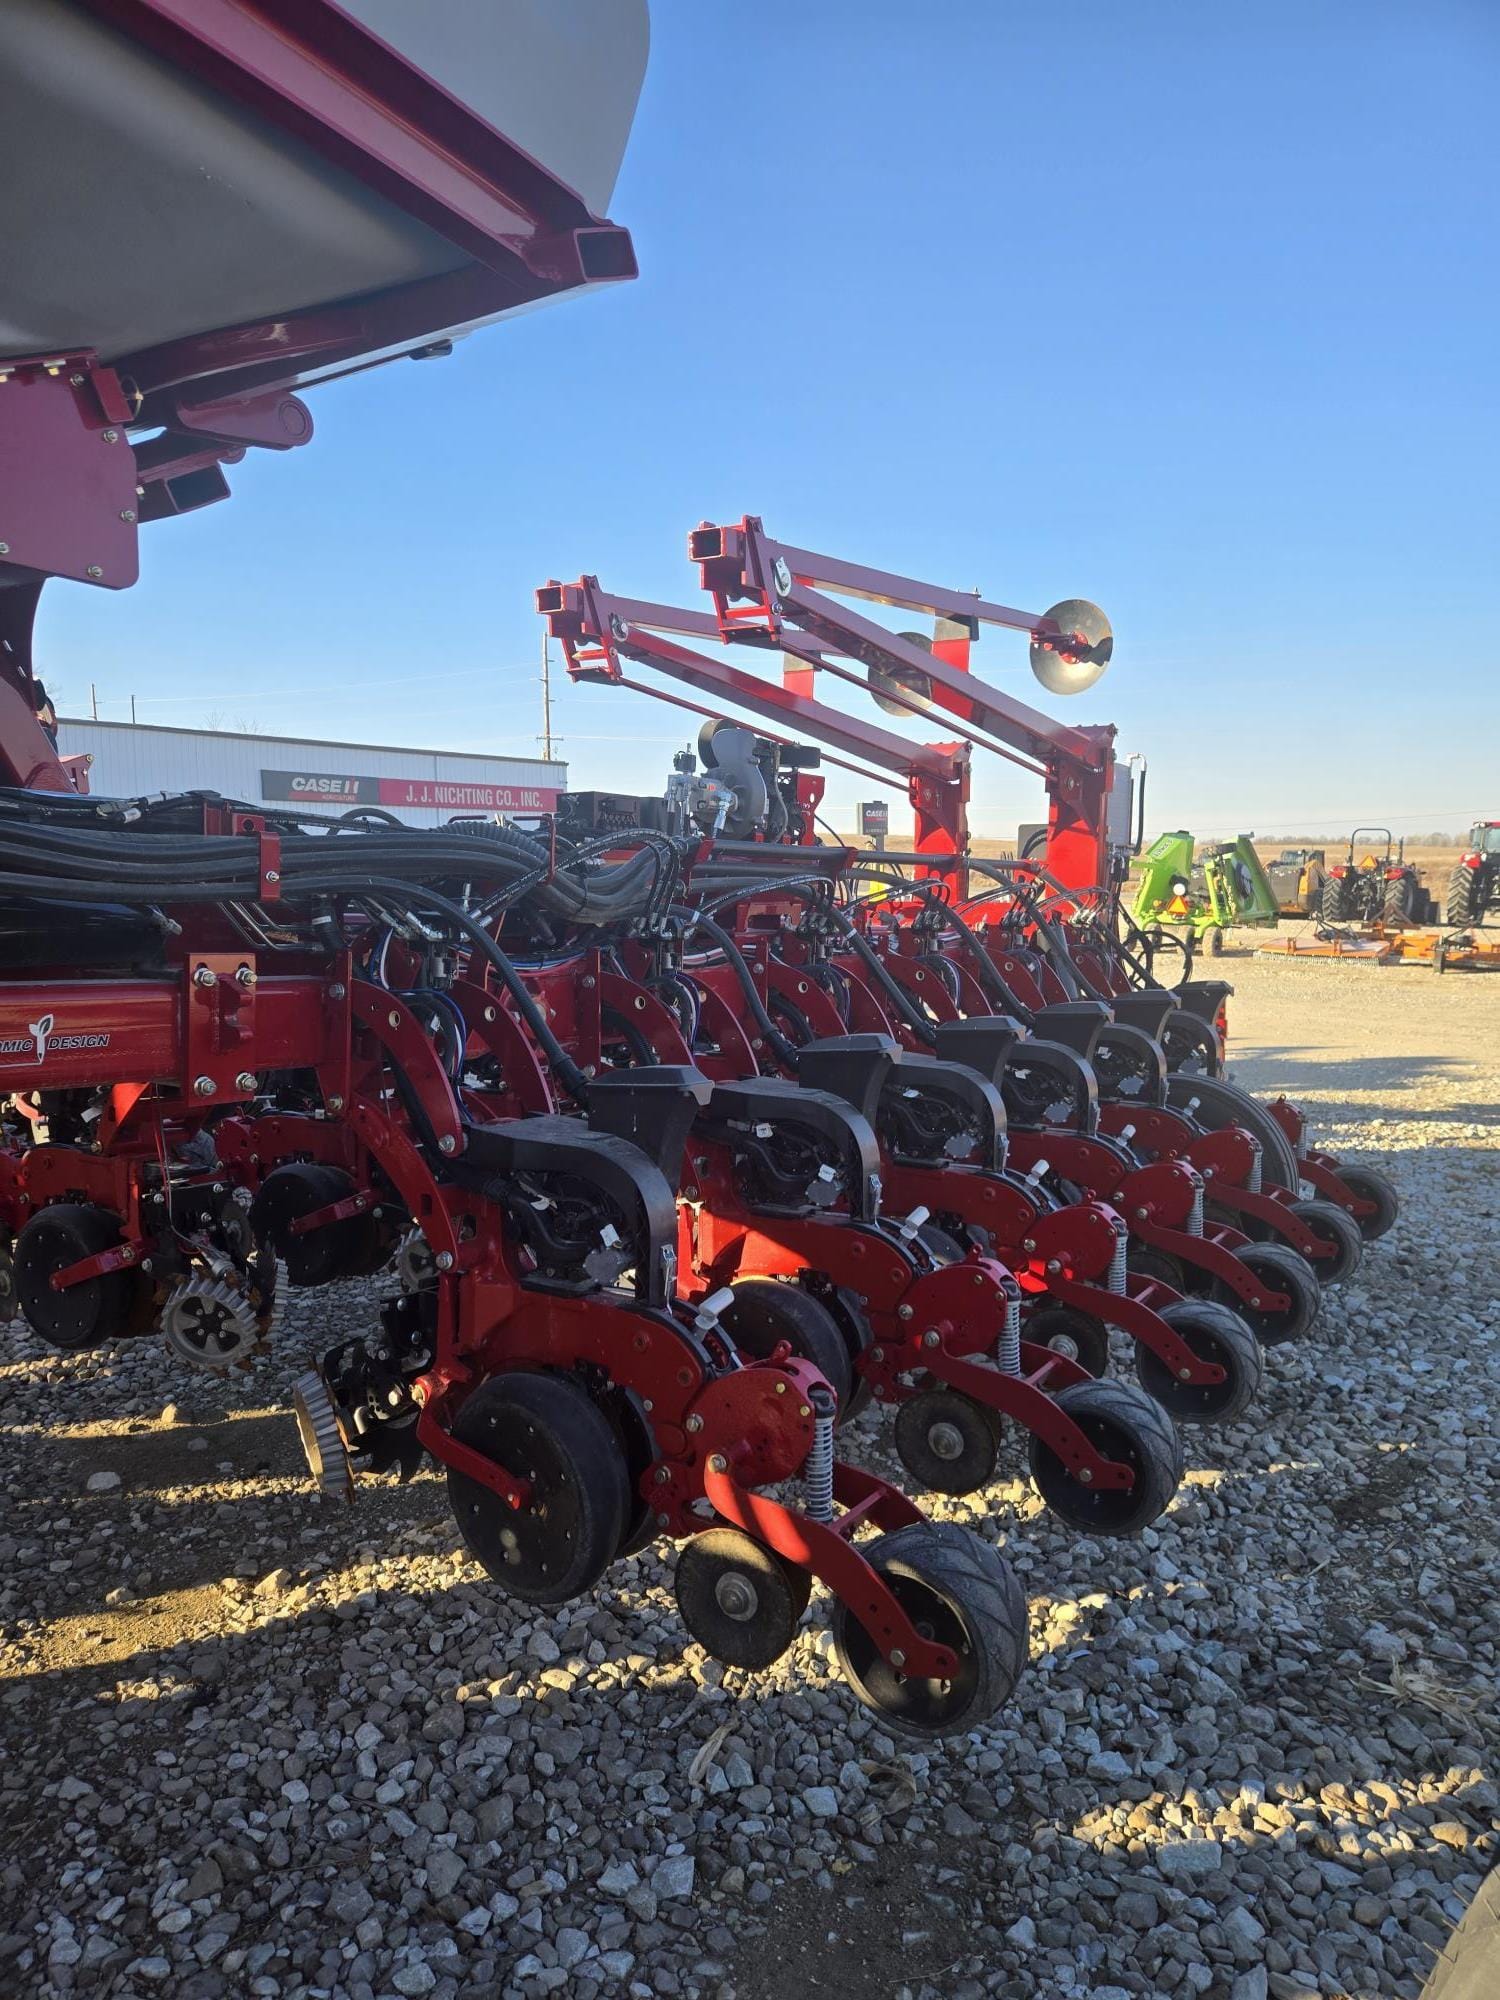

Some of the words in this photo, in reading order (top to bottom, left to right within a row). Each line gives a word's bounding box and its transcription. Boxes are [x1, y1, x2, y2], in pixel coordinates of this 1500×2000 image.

[291, 777, 342, 793] CASE
[406, 785, 417, 802] J.
[421, 786, 431, 803] J.
[434, 787, 493, 805] NICHTING
[496, 790, 519, 808] CO.,
[520, 791, 544, 808] INC.
[0, 1039, 33, 1053] MIC
[47, 1034, 110, 1050] DESIGN
